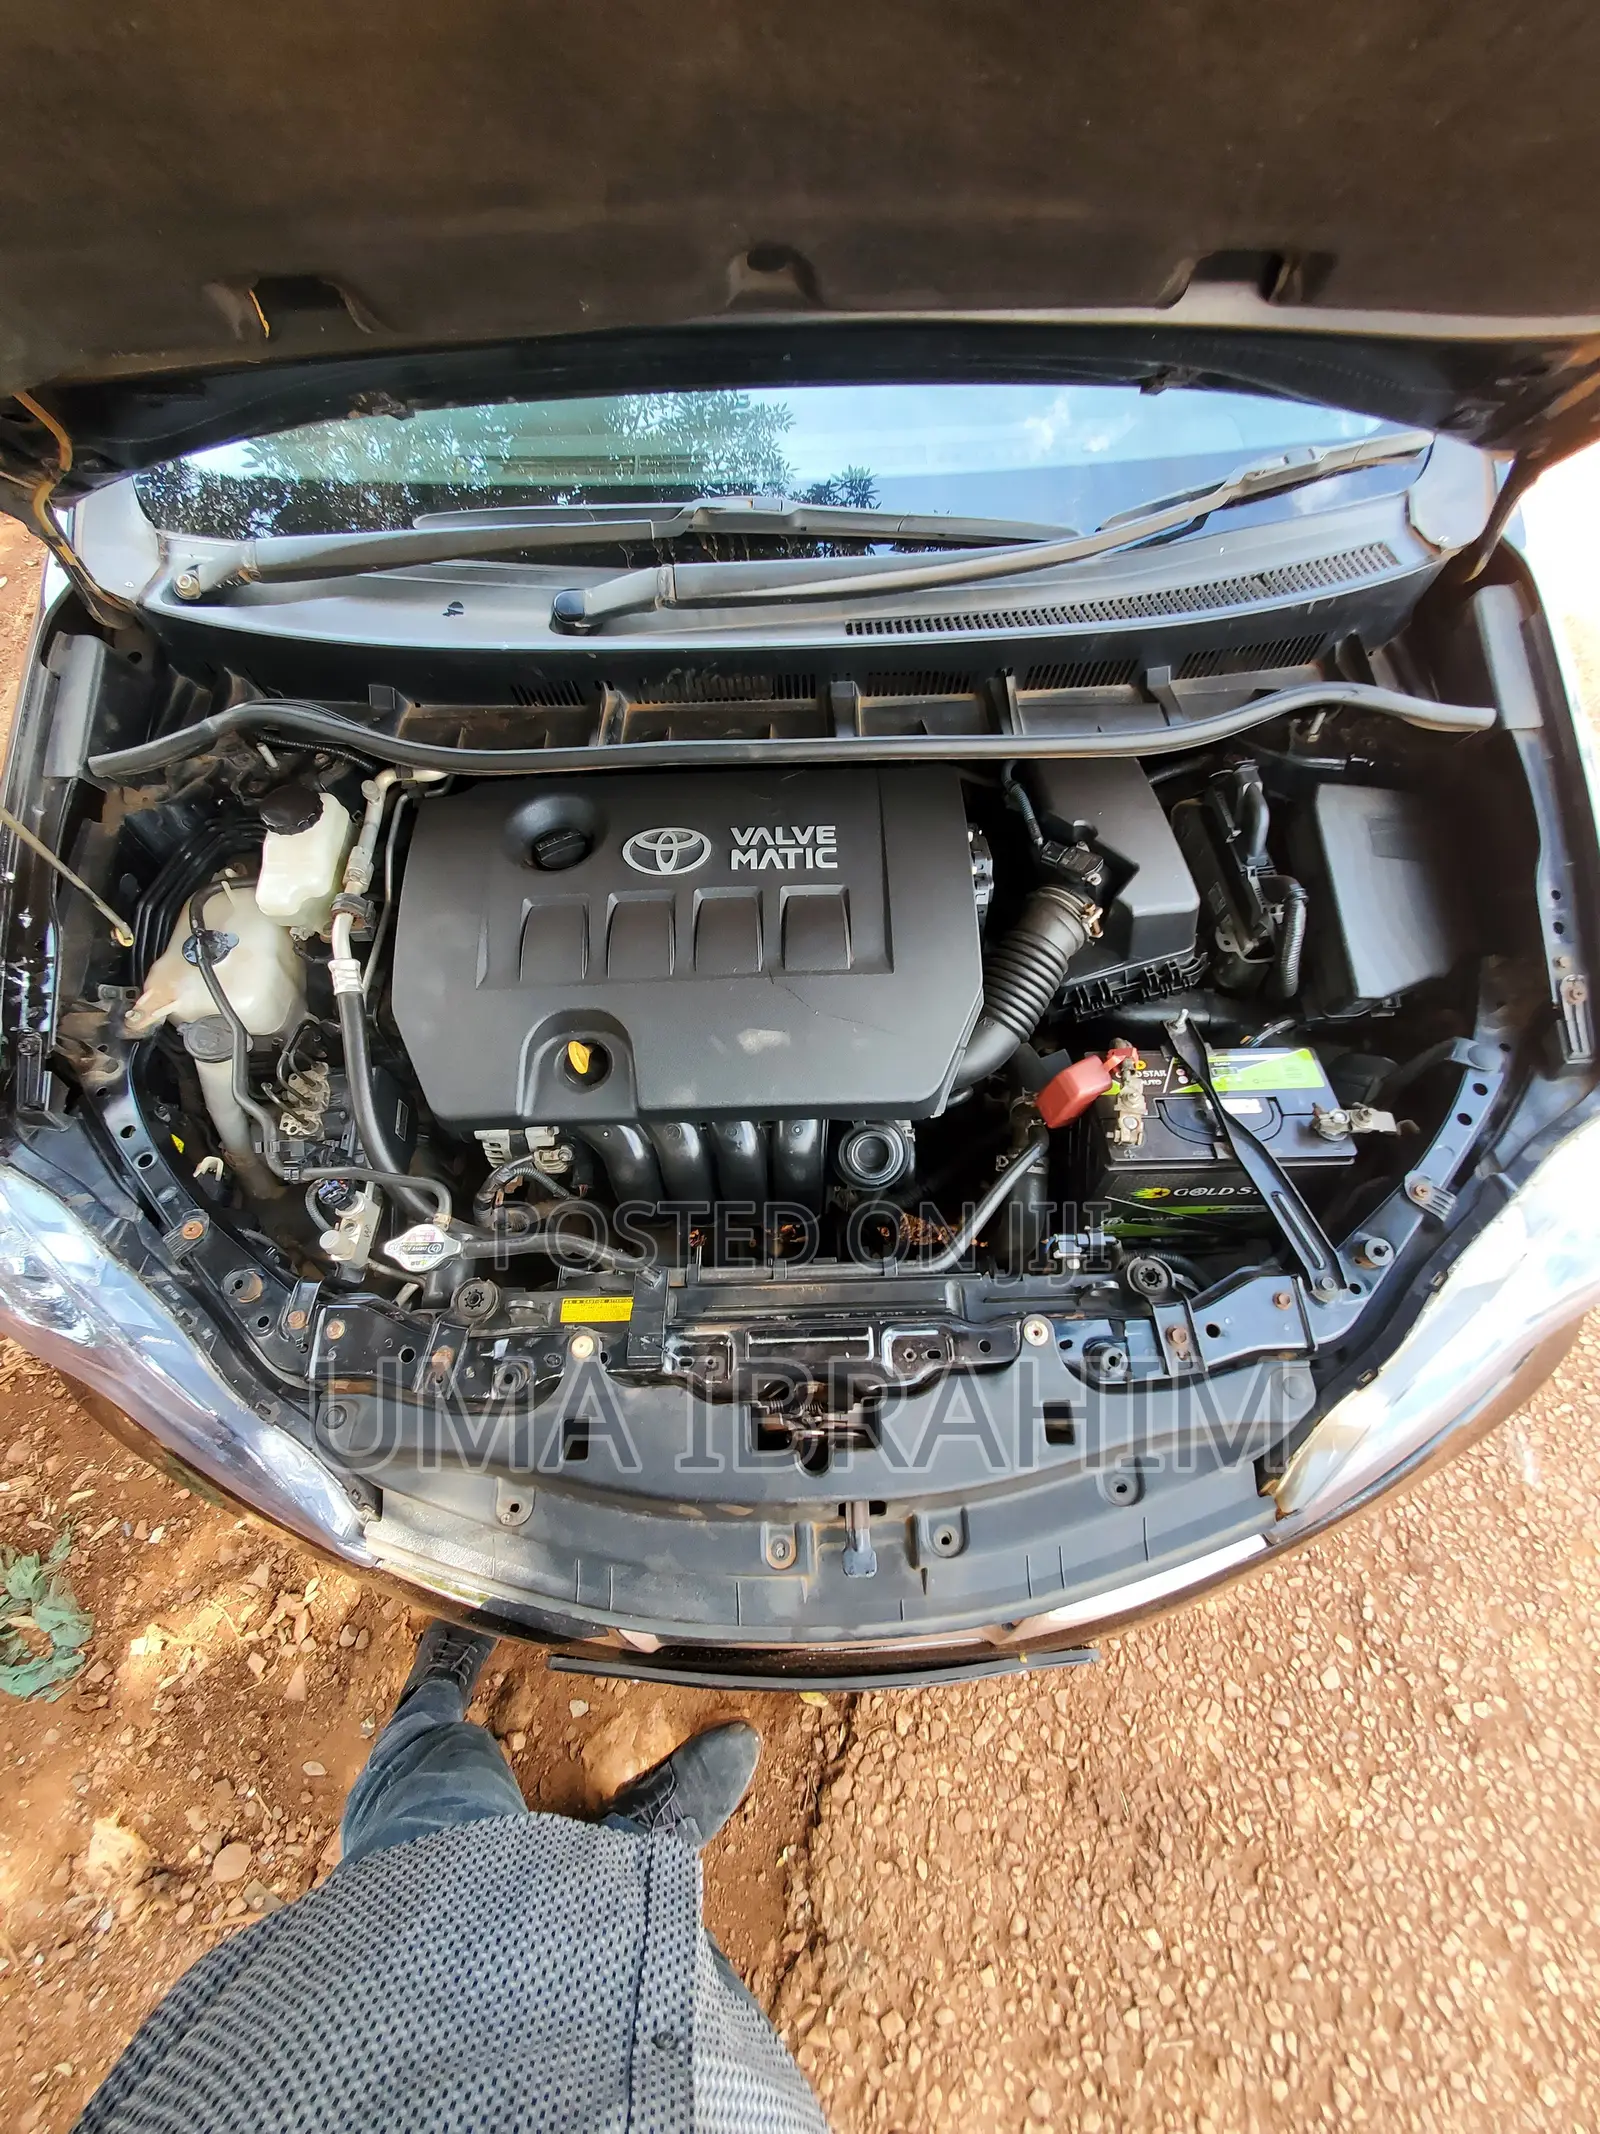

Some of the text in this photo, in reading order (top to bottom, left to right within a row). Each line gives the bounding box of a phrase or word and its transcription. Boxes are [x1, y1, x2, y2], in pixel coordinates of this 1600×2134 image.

[730, 825, 837, 846] VALVE
[731, 847, 838, 870] MATIC
[1142, 1069, 1167, 1078] STAR
[1173, 1187, 1235, 1197] GOLD
